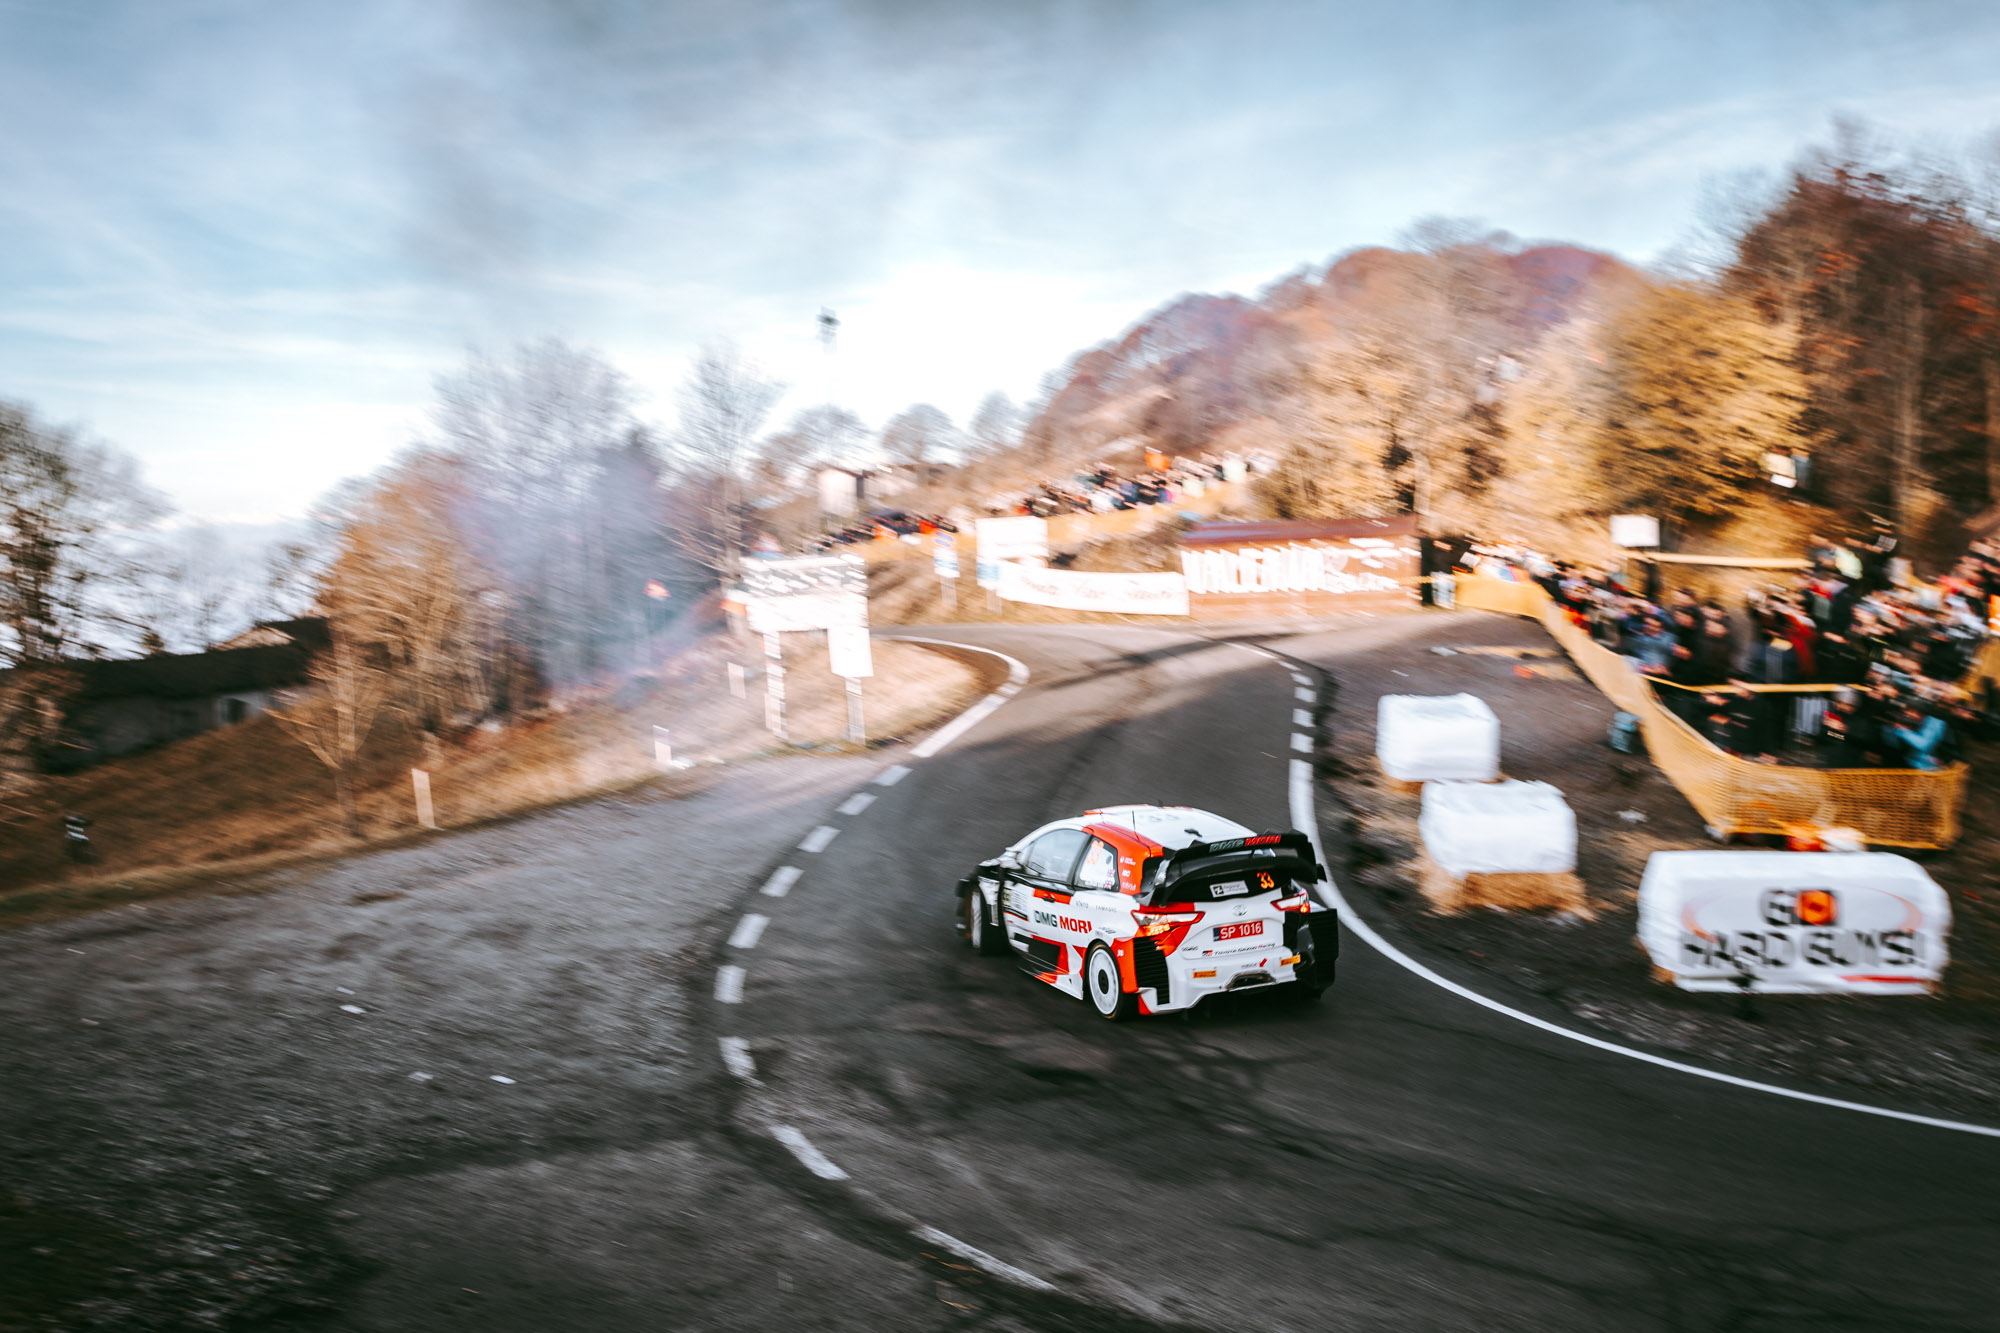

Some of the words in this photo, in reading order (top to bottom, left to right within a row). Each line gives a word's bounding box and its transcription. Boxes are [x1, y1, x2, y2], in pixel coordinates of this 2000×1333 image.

[1256, 872, 1275, 889] 33
[1034, 911, 1057, 927] DMG
[1059, 915, 1092, 933] MORI
[1220, 926, 1236, 939] SP
[1239, 922, 1262, 936] 1016
